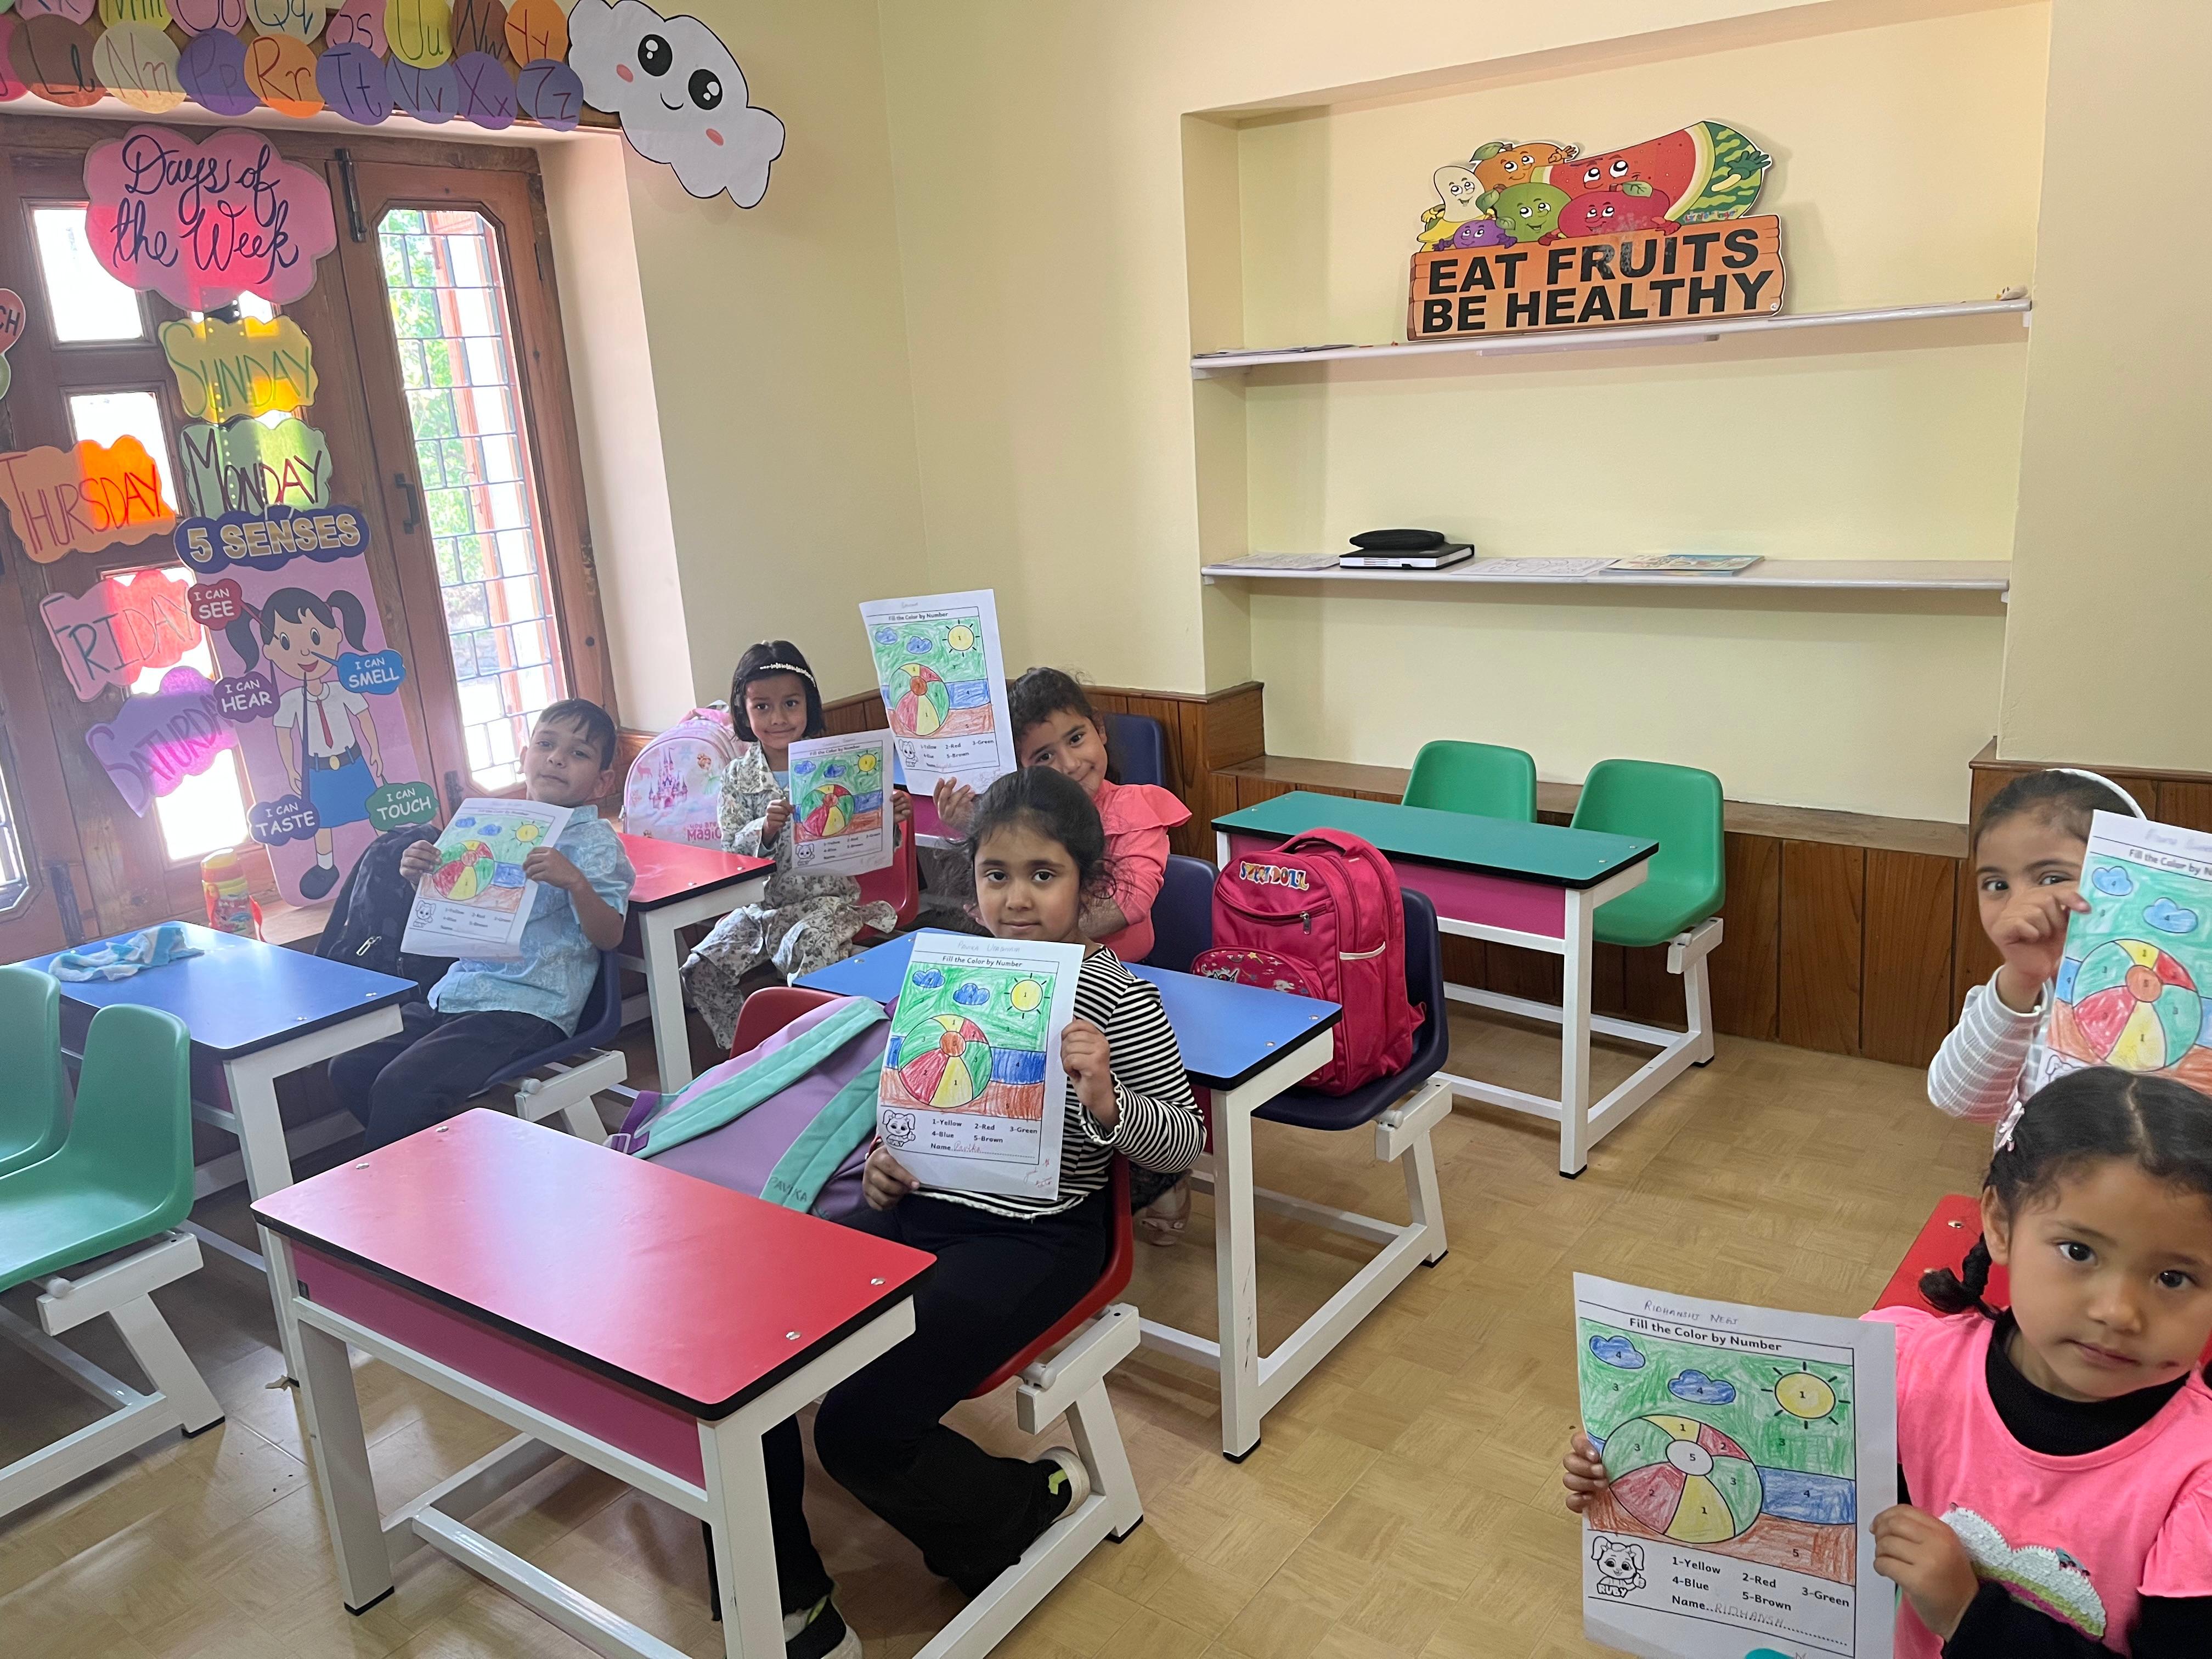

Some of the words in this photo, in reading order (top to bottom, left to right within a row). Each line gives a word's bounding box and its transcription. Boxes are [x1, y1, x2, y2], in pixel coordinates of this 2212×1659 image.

[106, 32, 173, 99] Nn
[190, 33, 238, 106] Pp
[253, 37, 312, 103] Rr
[323, 53, 382, 117] Tt
[122, 134, 232, 225] Days
[234, 144, 280, 227] of
[111, 198, 179, 269] the
[179, 199, 299, 285] Week
[1429, 251, 1528, 295] EAT
[1547, 229, 1759, 285] FRUITS
[1422, 295, 1487, 334] BE
[1506, 270, 1775, 328] HEALTHY
[163, 321, 311, 417] SUNDAY
[183, 428, 323, 517] MONDAY
[0, 454, 161, 554] THURSDAY
[187, 527, 215, 563] 5
[219, 513, 361, 560] SENSES
[193, 591, 201, 601] I
[205, 588, 230, 600] CAN
[199, 600, 235, 619] SEE
[42, 586, 194, 692] FRIDAY
[355, 661, 362, 670] I
[364, 657, 386, 668] CAN
[224, 684, 232, 694] I
[236, 679, 261, 691] CAN
[348, 668, 400, 688] SMELL
[221, 691, 273, 713] HEAR
[89, 695, 234, 814] SATURDA
[387, 792, 393, 802] I
[394, 787, 416, 799] CAN
[266, 808, 272, 817] I
[276, 802, 299, 814] CAN
[377, 796, 432, 821] TOUCH
[256, 810, 315, 837] TASTE
[986, 959, 995, 967] by
[932, 1119, 962, 1127] 1-Yellow
[1629, 1318, 1647, 1330] Fill
[1652, 1323, 1671, 1334] the
[1675, 1327, 1708, 1341] Color
[1712, 1333, 1726, 1345] by
[1730, 1336, 1782, 1351] Number
[1613, 1383, 1619, 1391] 3
[1680, 1424, 1686, 1432] 1
[1634, 1443, 1640, 1452] 3
[1720, 1442, 1726, 1450] 2
[1779, 1438, 1785, 1446] 3
[1690, 1453, 1696, 1462] 5
[1730, 1477, 1736, 1486] 3
[1803, 1489, 1810, 1498] 4
[1701, 1506, 1708, 1515] 1
[1793, 1549, 1799, 1558] 5
[1598, 1583, 1628, 1598] RUBY
[1672, 1556, 1721, 1575] 1-Yellow
[1742, 1573, 1776, 1588] 2-Red
[1801, 1587, 1850, 1607] 3-Green
[1672, 1576, 1709, 1591] 4-Blue
[1742, 1591, 1792, 1611] 5-Brown
[1672, 1595, 1709, 1610] Name
